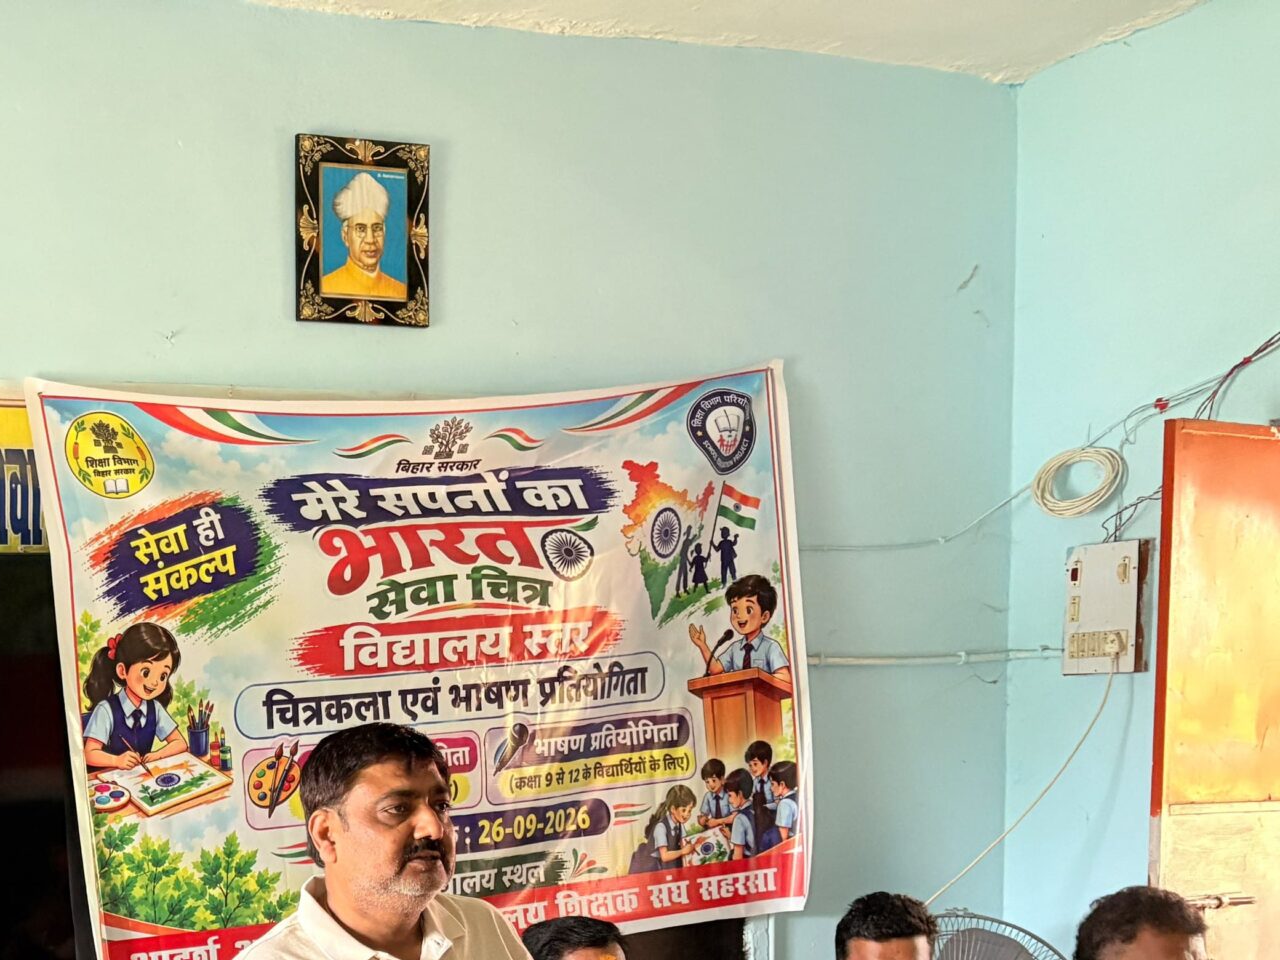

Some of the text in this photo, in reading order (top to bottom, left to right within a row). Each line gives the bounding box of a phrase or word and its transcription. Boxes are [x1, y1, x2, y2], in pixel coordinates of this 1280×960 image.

[85, 454, 139, 468] शिक्षा विभाग
[395, 458, 483, 474] बिहार सरकार
[291, 470, 591, 522] मेरे सपनों का
[130, 507, 225, 565] सेवा ही
[318, 518, 550, 596] भारत
[140, 544, 237, 601] संकल्प
[367, 565, 553, 620] सेवा चित्र
[340, 621, 592, 671] विद्यालय स्तर
[262, 661, 648, 730] चित्रकला एवं भाषण प्रतियोगिता
[534, 719, 679, 757] भाषण प्रतियोगिता
[509, 752, 690, 793] (कक्षा 9 से 12 के विद्यार्थियों के लिए)
[478, 804, 591, 845] 26-09-2026
[502, 860, 546, 888] स्थल
[647, 876, 689, 909] संघ
[697, 868, 778, 901] सहरसा
